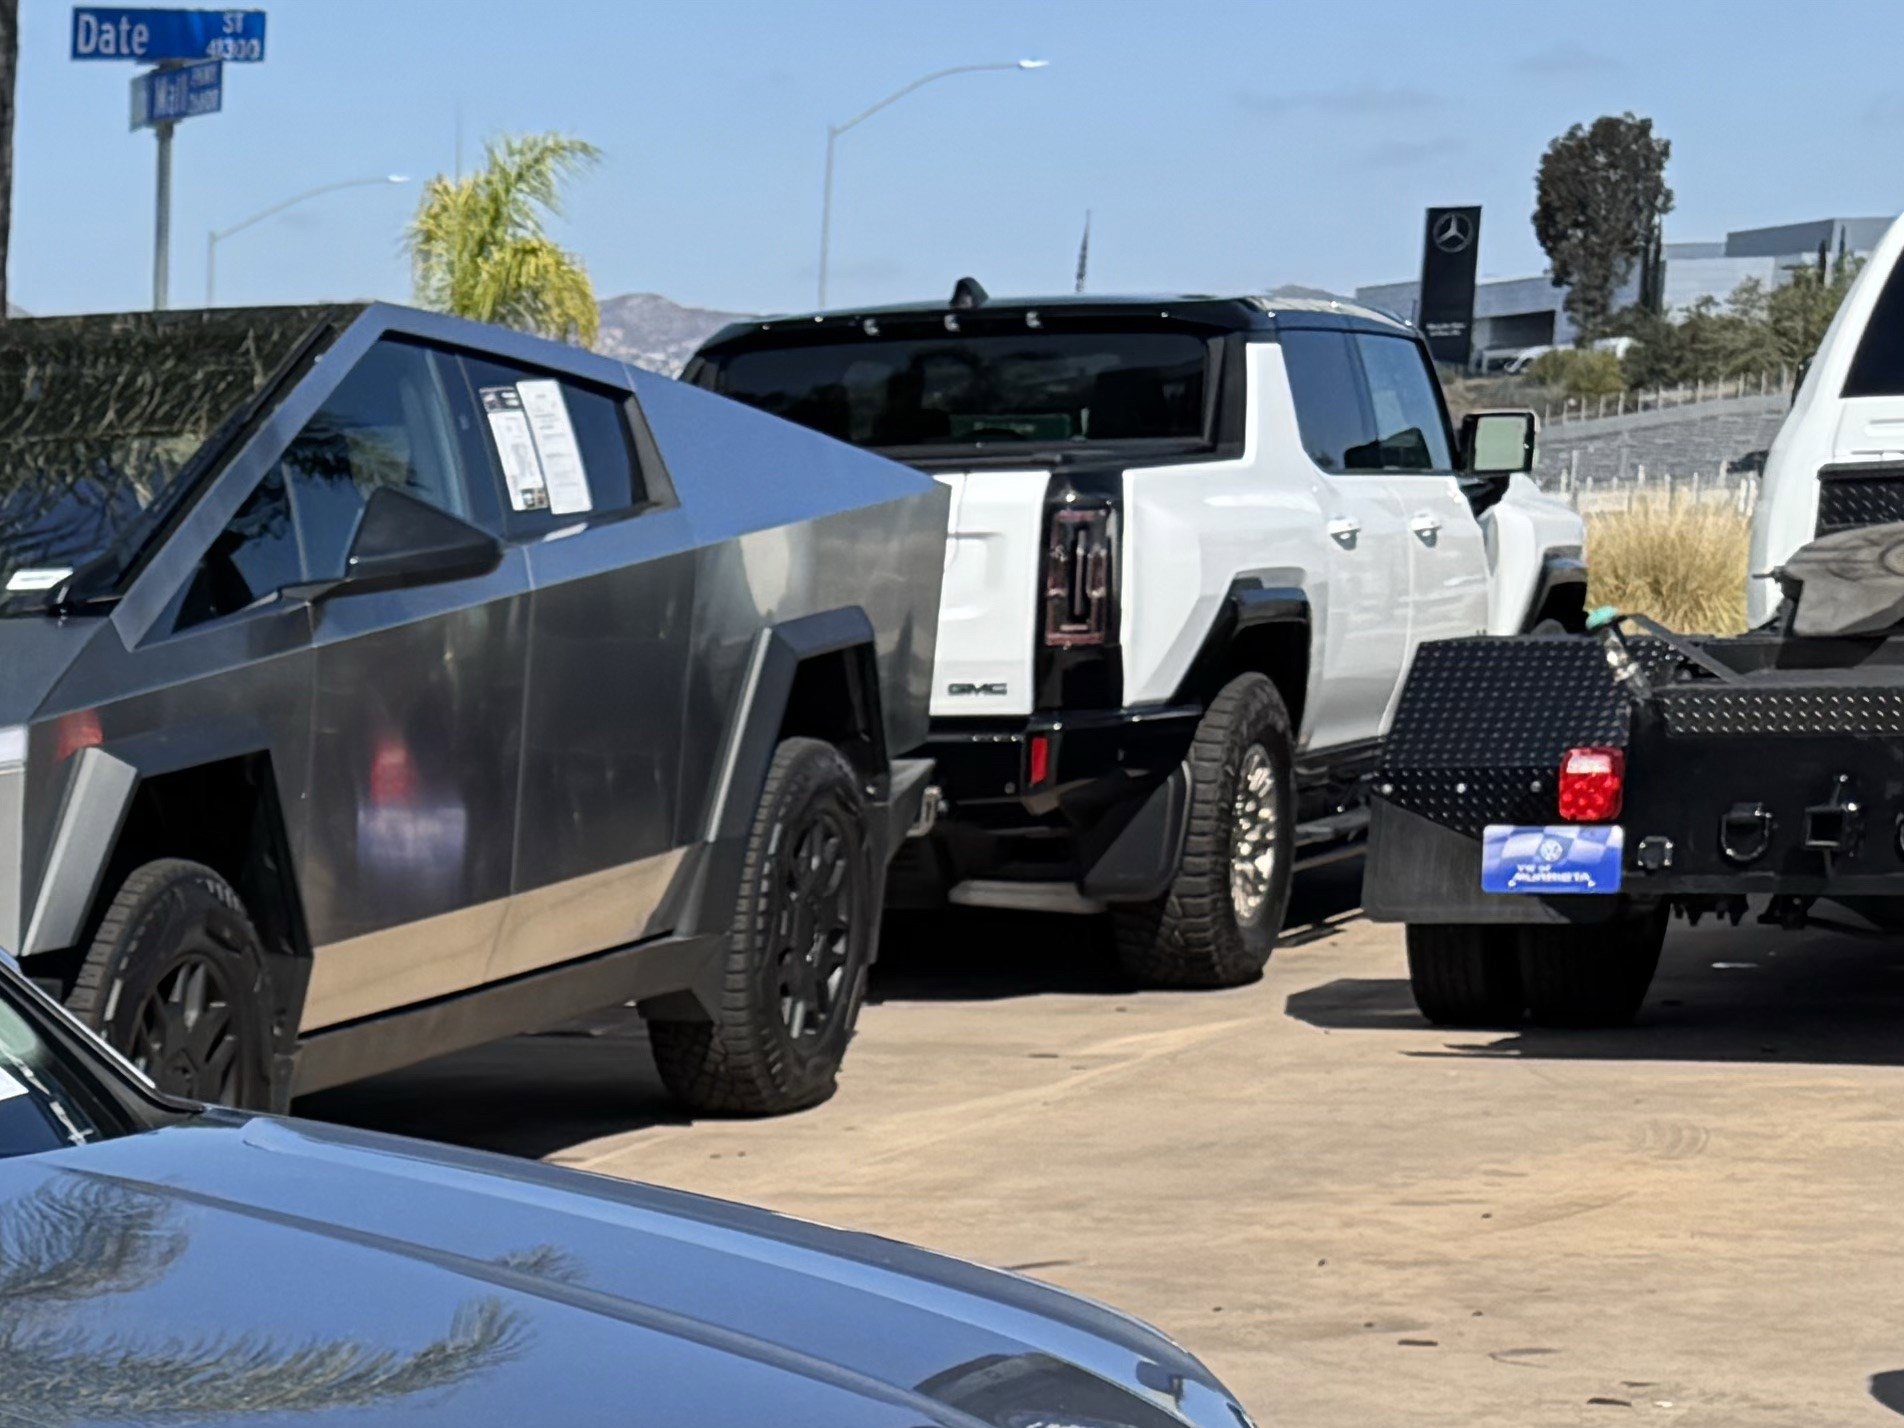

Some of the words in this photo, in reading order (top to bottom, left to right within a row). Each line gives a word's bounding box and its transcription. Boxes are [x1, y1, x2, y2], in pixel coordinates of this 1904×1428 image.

[76, 13, 150, 55] Date
[222, 11, 245, 34] ST
[948, 682, 1008, 696] GMC
